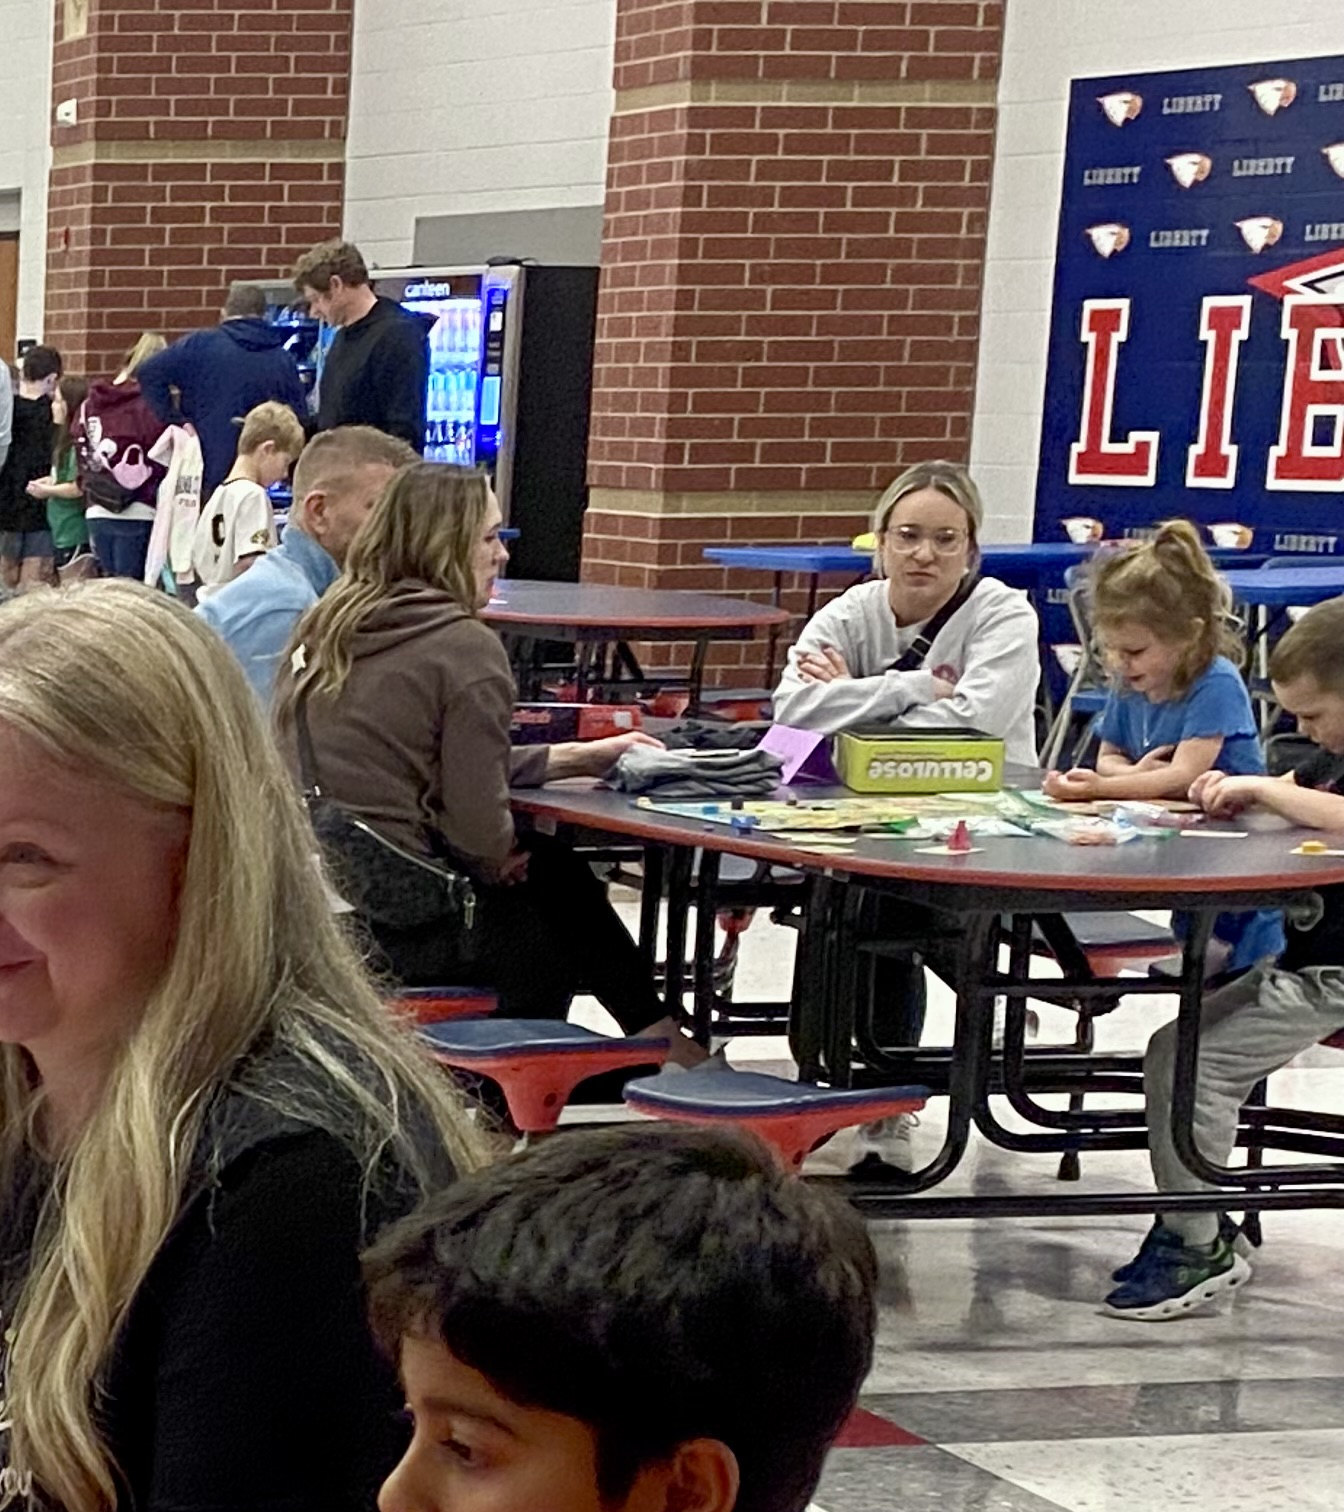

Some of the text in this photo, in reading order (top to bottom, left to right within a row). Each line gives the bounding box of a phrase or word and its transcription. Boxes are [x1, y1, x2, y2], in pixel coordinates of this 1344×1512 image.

[1161, 94, 1222, 115] LIBERTY
[1083, 166, 1142, 186] LIBERTY
[1232, 157, 1295, 177] LIBERTY
[1149, 229, 1210, 247] LIBERTY
[404, 279, 451, 298] canteen
